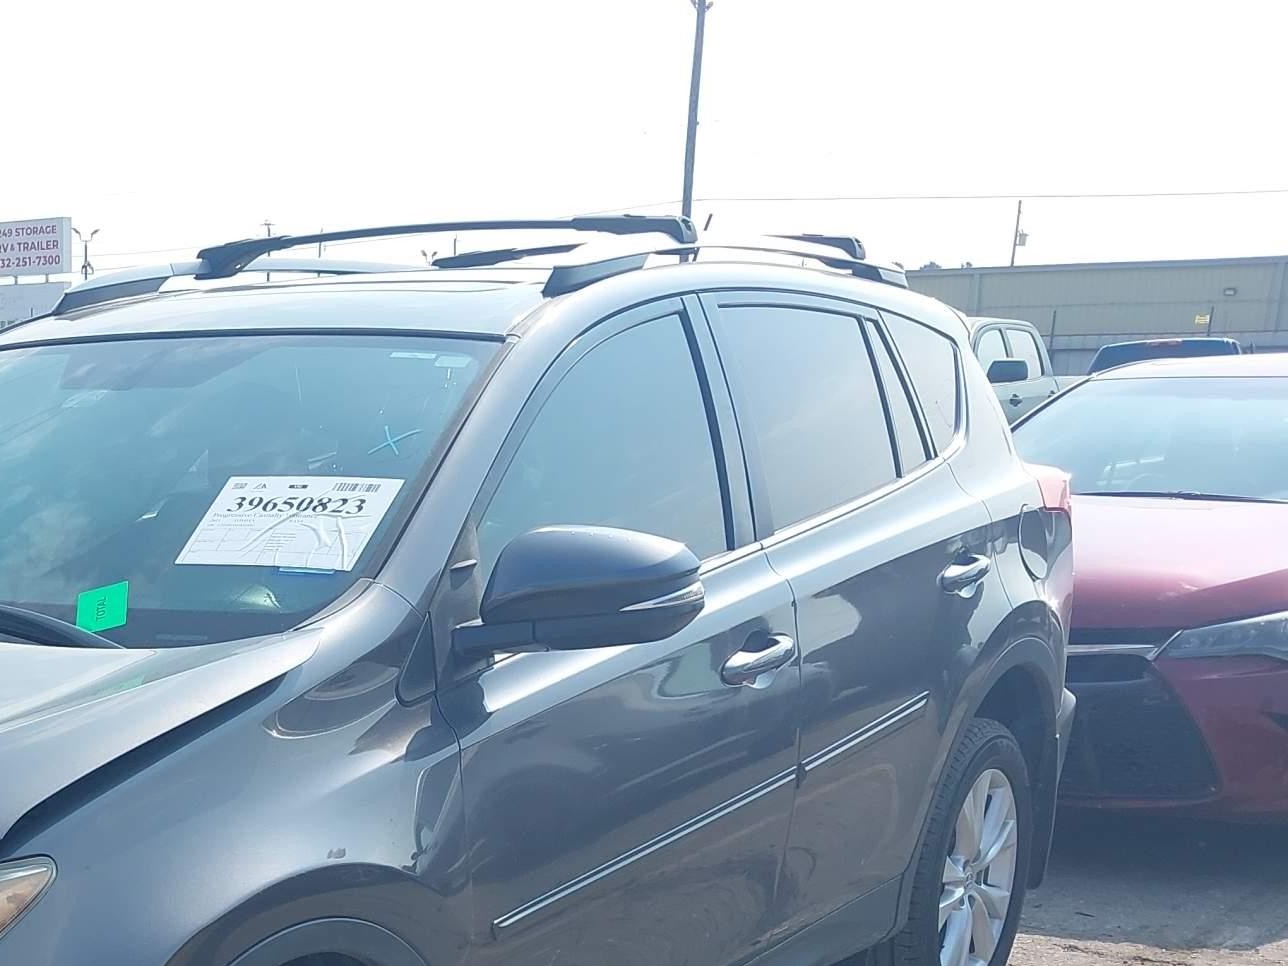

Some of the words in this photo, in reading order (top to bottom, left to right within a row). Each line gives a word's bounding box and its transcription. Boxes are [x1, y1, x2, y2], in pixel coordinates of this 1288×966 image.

[15, 225, 57, 237] STORAGE
[17, 240, 59, 252] TRAILER
[226, 496, 367, 514] 39650823
[95, 595, 107, 622] TOTAL
